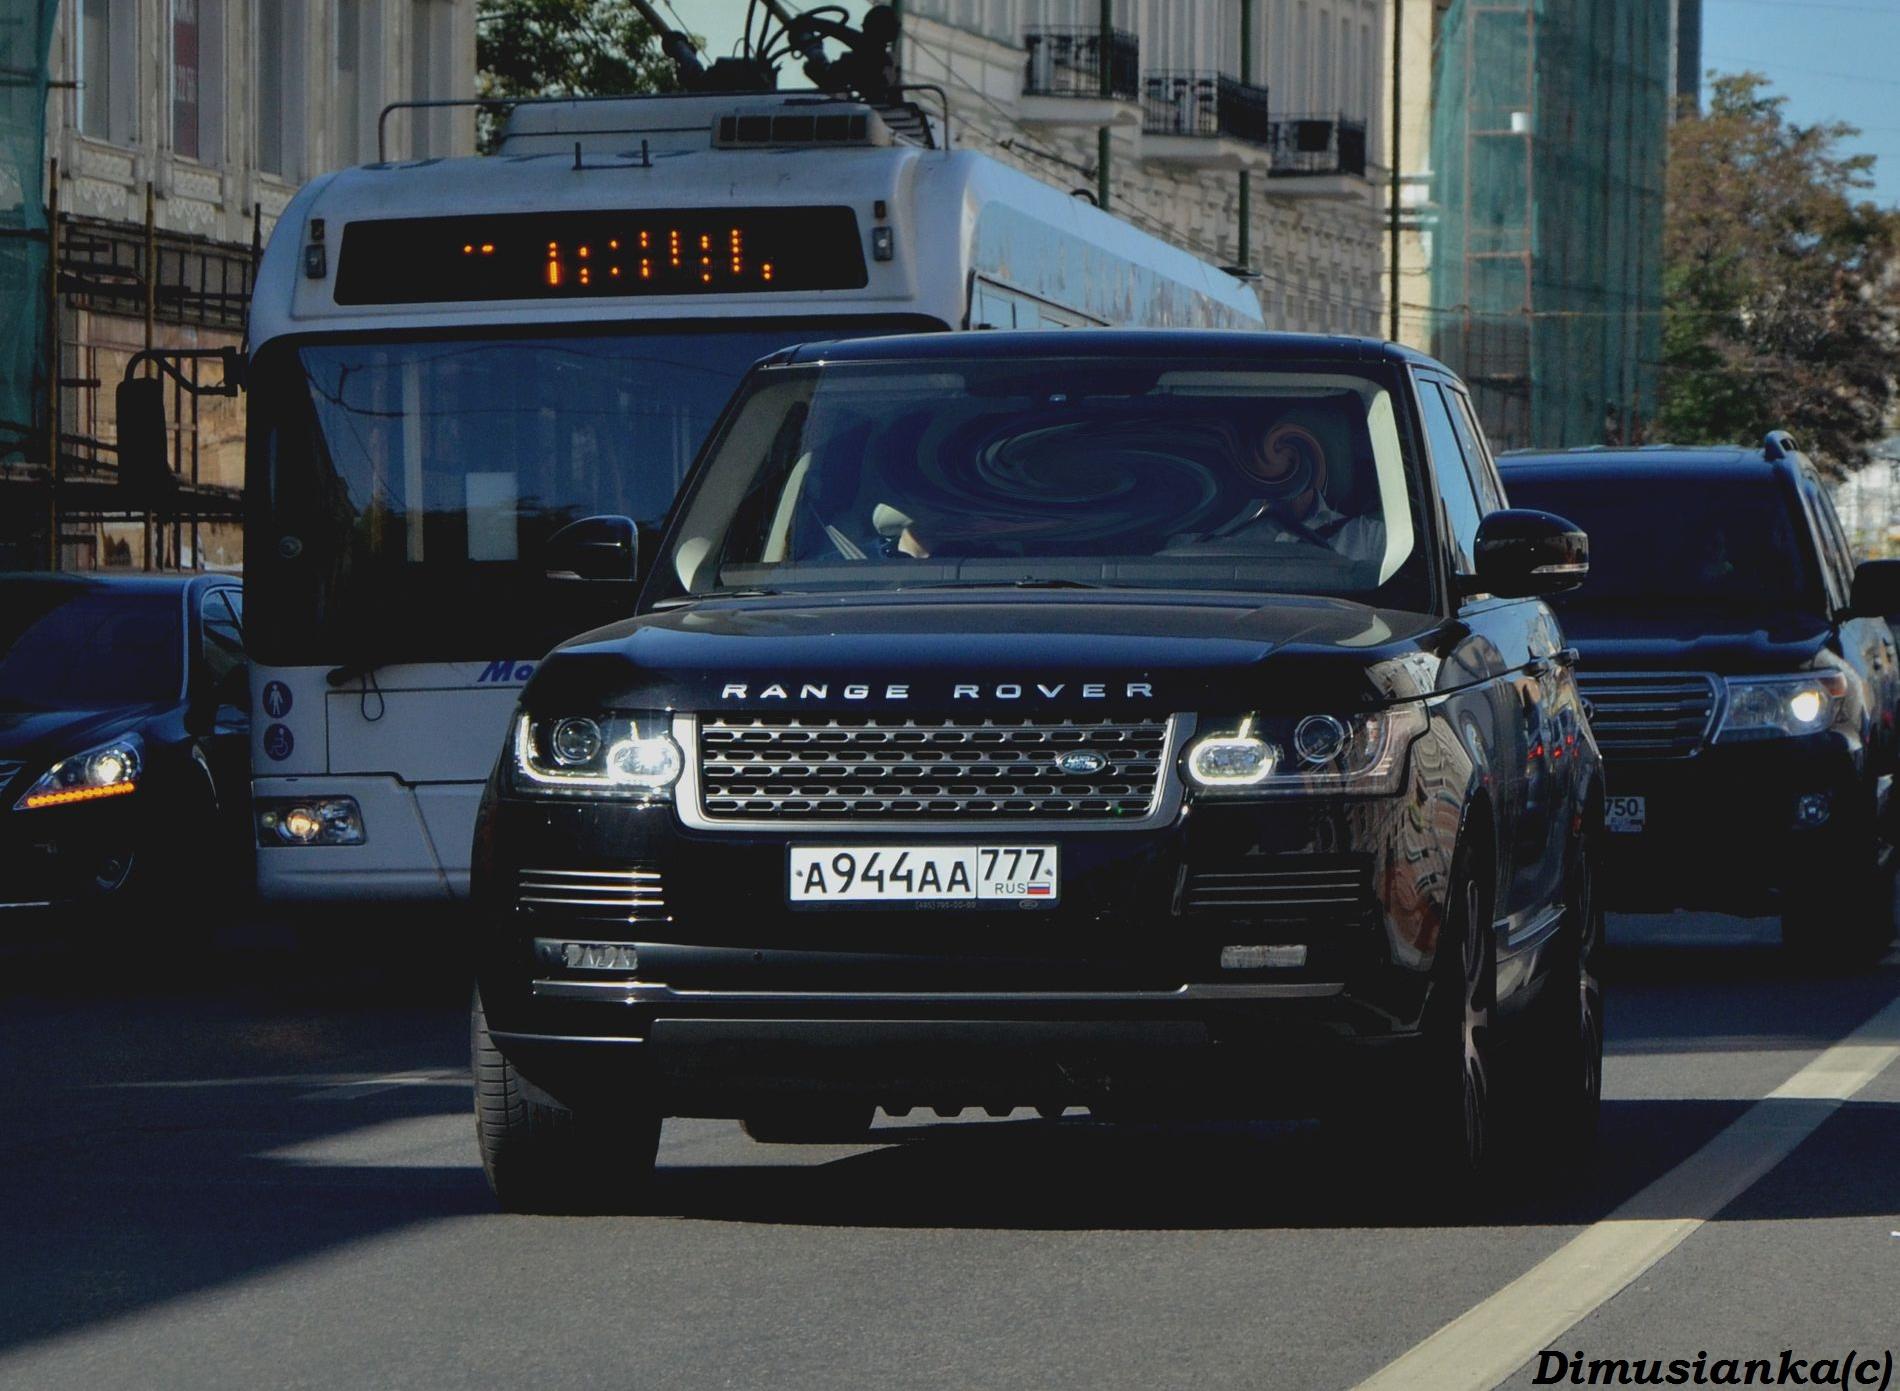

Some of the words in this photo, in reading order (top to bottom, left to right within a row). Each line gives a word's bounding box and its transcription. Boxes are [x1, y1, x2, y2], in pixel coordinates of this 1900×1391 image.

[722, 683, 910, 700] RANGE
[953, 682, 1154, 699] ROVER
[1604, 798, 1639, 817] 750
[981, 849, 1045, 881] 777
[995, 882, 1026, 894] RUS
